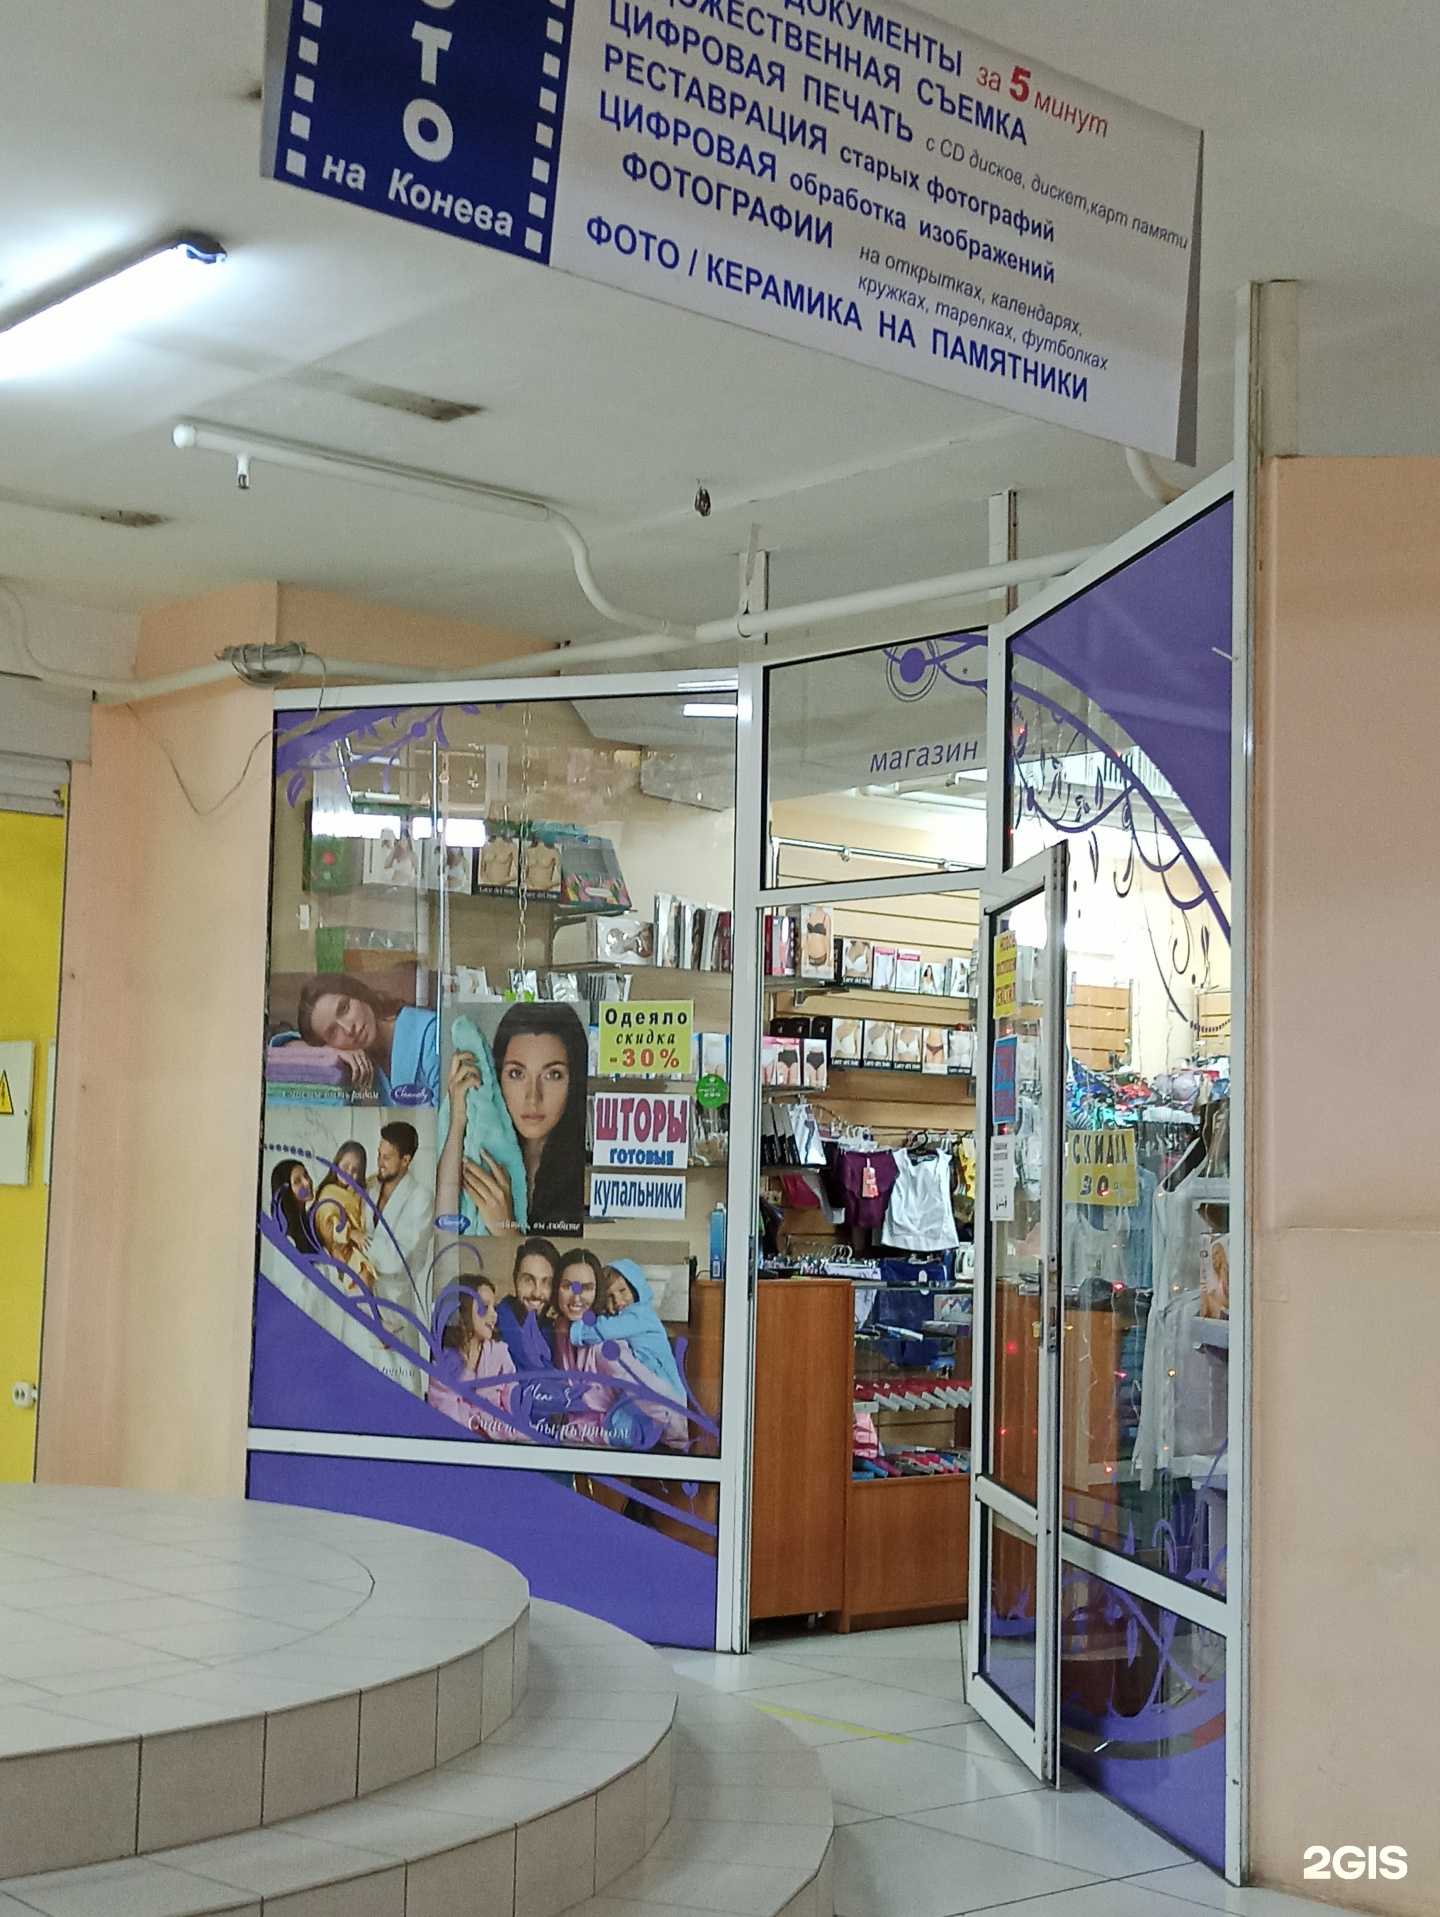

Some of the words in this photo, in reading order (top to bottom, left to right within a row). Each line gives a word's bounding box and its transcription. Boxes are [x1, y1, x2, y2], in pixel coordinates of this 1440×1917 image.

[402, 0, 456, 163] ТО
[917, 77, 1028, 146] СЪЕМКА
[975, 66, 1001, 92] за
[1009, 65, 1032, 103] 5
[1033, 91, 1109, 138] минут
[604, 43, 828, 155] РЕСТАВРАЦИЯ
[840, 146, 920, 190] старых
[927, 175, 1055, 242] фотографий
[609, 0, 786, 92] ЦИФРОВАЯ
[803, 74, 914, 142] ПЕЧАТЬ
[926, 136, 936, 152] с
[940, 138, 965, 163] CD
[969, 150, 1025, 189] дисков,
[1131, 216, 1189, 250] памяти
[322, 153, 367, 191] на
[388, 168, 514, 239] Конева
[600, 89, 777, 182] ЦИФРОВАЯ
[789, 172, 907, 230] обработка
[919, 219, 1055, 284] изображений
[622, 152, 834, 249] ФОТОГРАФИИ
[587, 215, 680, 270] ФОТО
[707, 253, 863, 331] КЕРАМИКА
[878, 310, 917, 348] НА
[932, 328, 1089, 402] ПАМЯТНИКИ
[858, 246, 880, 266] на
[885, 256, 985, 304] открытках,
[858, 274, 929, 314] кружках,
[935, 301, 1016, 343] тарелках,
[1021, 329, 1109, 370] футболках
[870, 741, 978, 773] магазин
[605, 1008, 687, 1028] Одеяло
[616, 1028, 675, 1045] скидка
[596, 1097, 688, 1143] ШТОРЫ
[594, 1180, 683, 1216] купальники
